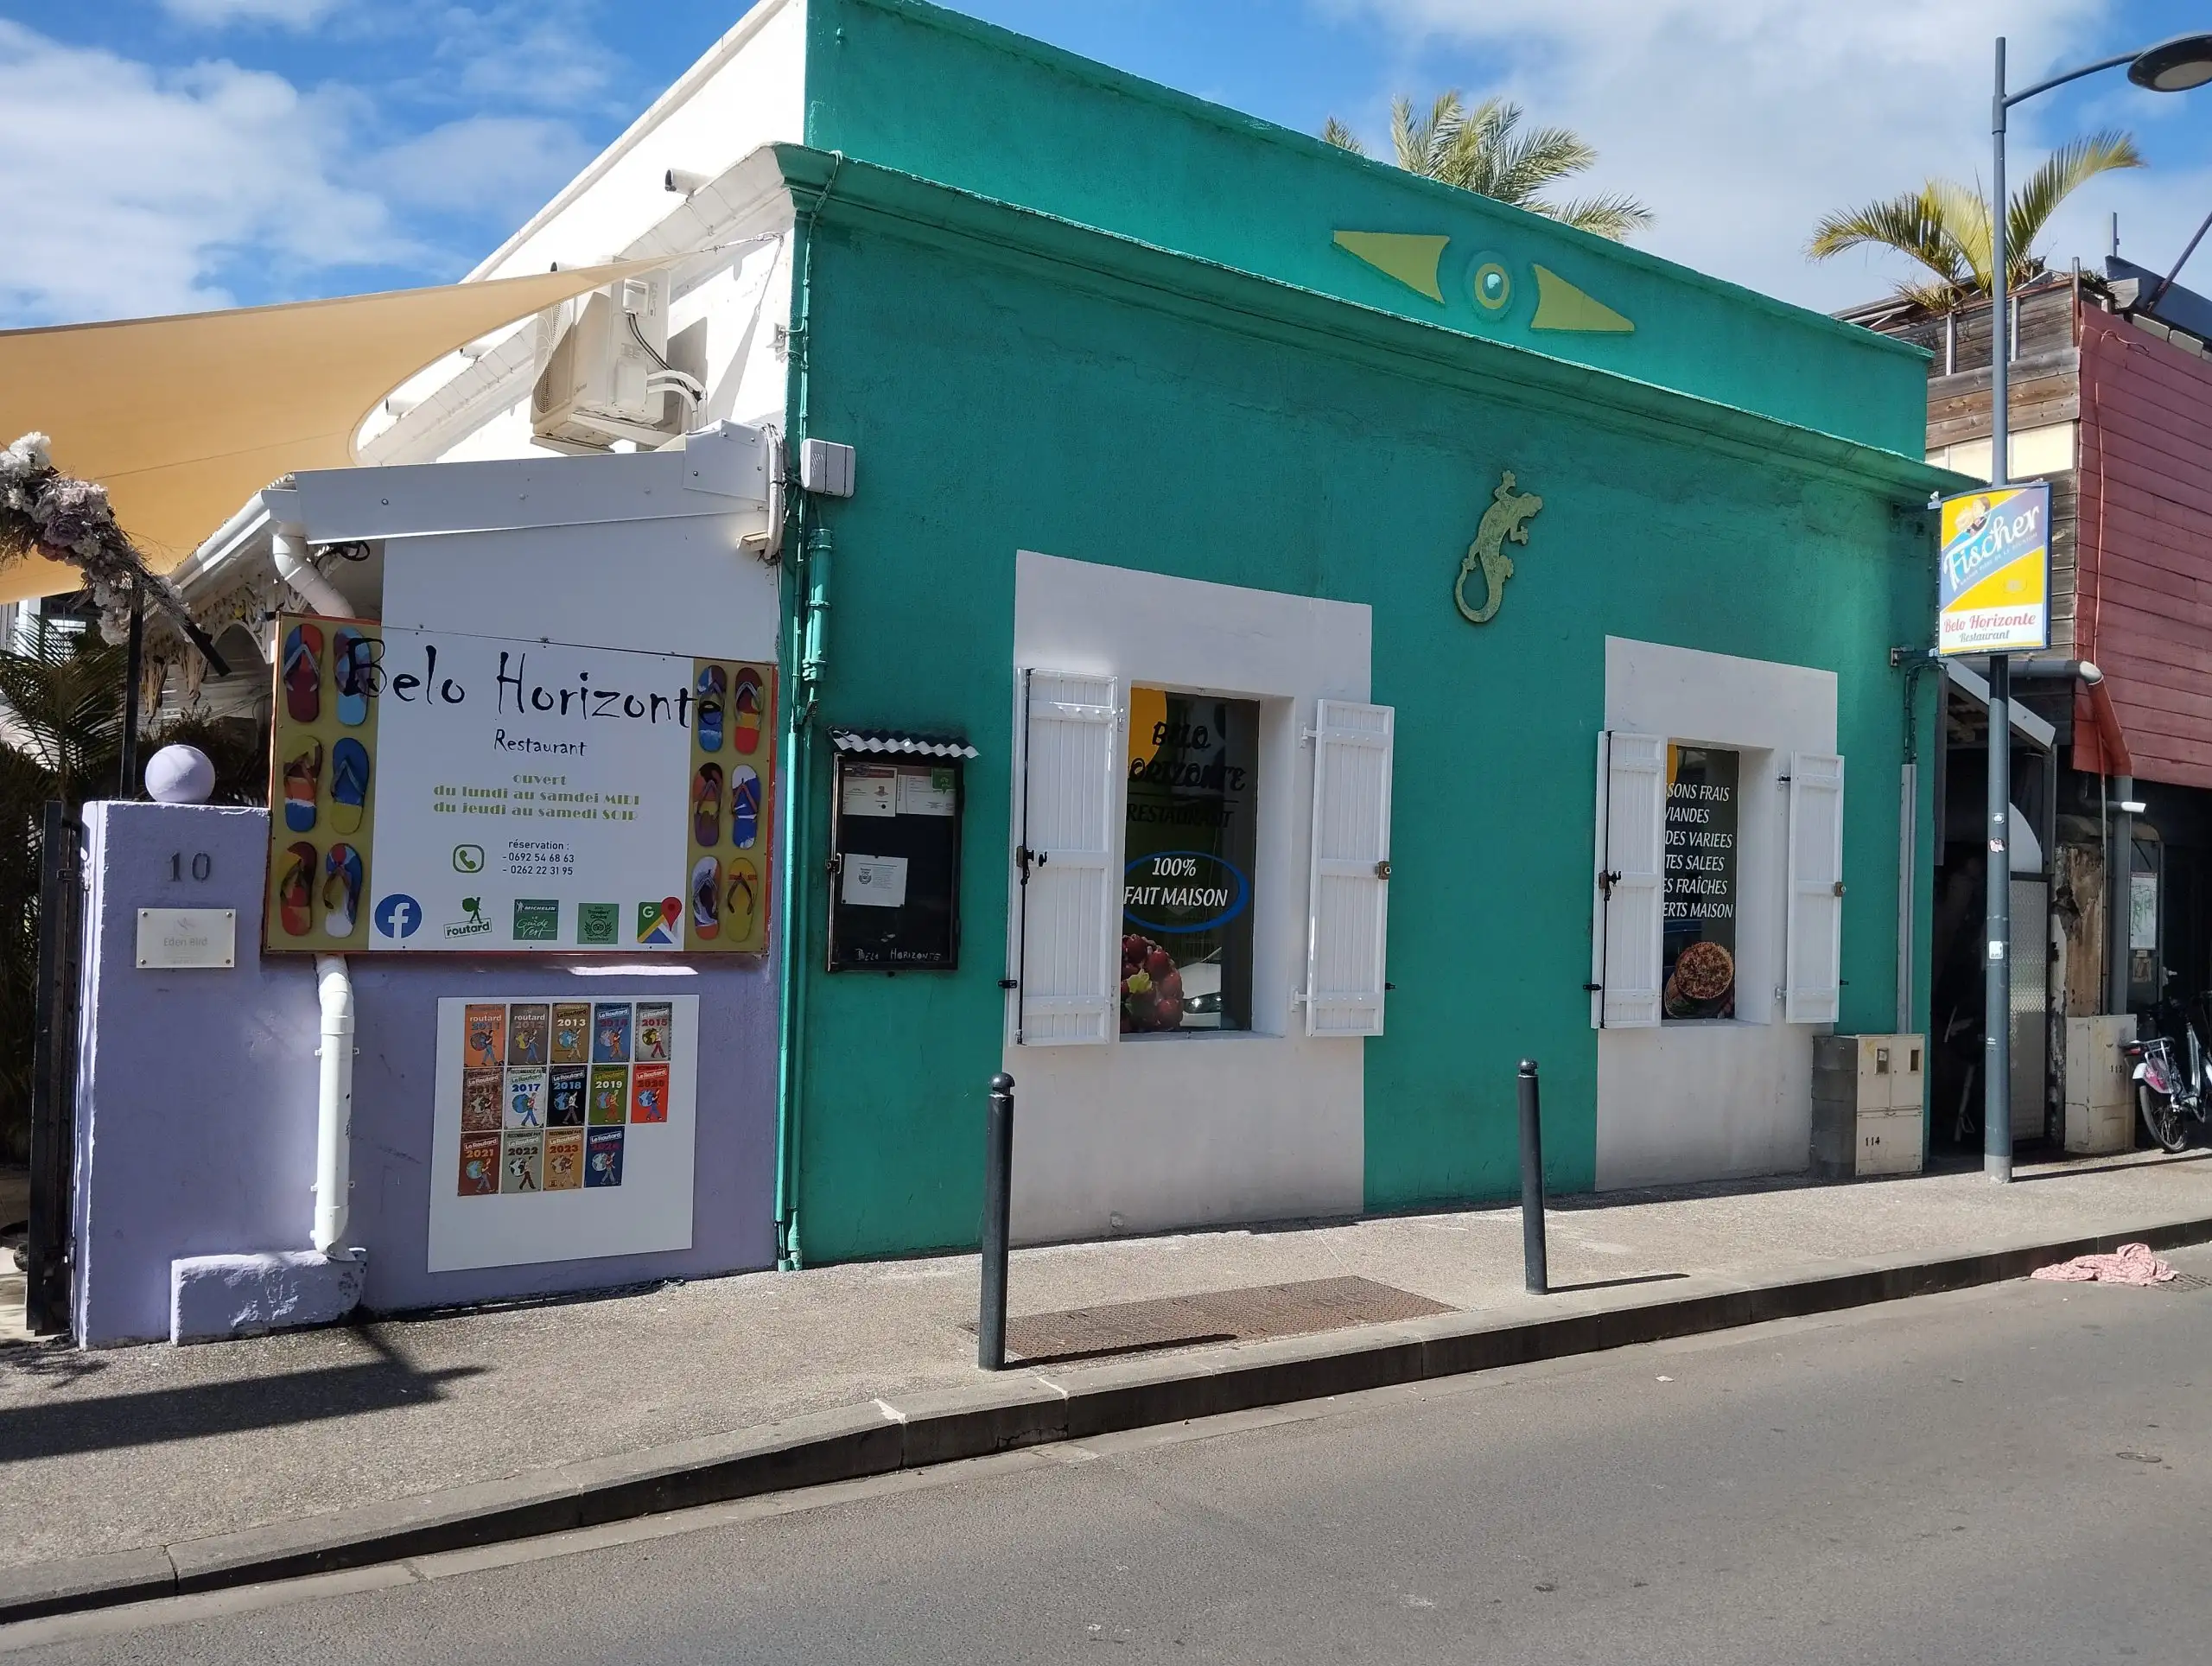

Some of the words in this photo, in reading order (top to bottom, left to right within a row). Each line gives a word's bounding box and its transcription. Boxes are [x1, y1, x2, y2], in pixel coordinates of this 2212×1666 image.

[1944, 506, 2039, 593] Fischer
[1944, 618, 1966, 633] Belo
[1969, 613, 2036, 630] Horizonte
[1960, 630, 2010, 643] Restaurant
[346, 637, 466, 705] Belo
[495, 652, 724, 728] Horizonte
[493, 729, 588, 757] Restaurant
[513, 774, 567, 785] ouvert
[433, 785, 456, 796] du
[462, 786, 508, 798] lundi
[513, 790, 534, 800] au
[539, 792, 599, 804] samdei
[603, 794, 639, 805] MIDI
[1700, 785, 1730, 802] FRAIS
[433, 802, 456, 812] du
[461, 802, 506, 815] jeudi
[512, 806, 533, 816] au
[537, 809, 597, 819] samedi
[508, 839, 564, 850] réservation
[1688, 832, 1733, 849] VARIEES
[534, 853, 546, 862] 54
[549, 854, 561, 862] 68
[563, 854, 575, 863] 63
[1686, 855, 1725, 871] SALEES
[168, 851, 211, 882] 10
[536, 866, 547, 874] 22
[562, 867, 573, 875] 95
[1152, 857, 1197, 876] 100%
[1676, 875, 1728, 895] FRAÎCHES
[1123, 886, 1160, 906] FAIT
[1161, 887, 1228, 907] MAISON
[1689, 903, 1733, 919] MAISON
[447, 921, 490, 936] routard
[516, 919, 549, 929] Guide
[522, 926, 556, 938] Vert
[163, 938, 187, 946] Eden
[561, 1071, 583, 1080] Routard
[512, 1084, 541, 1092] 2017
[473, 1138, 498, 1148] Routard
[515, 1137, 540, 1146] Routard
[556, 1135, 582, 1144] Routard
[599, 1133, 621, 1141] Routard
[1865, 1136, 1880, 1147] 114
[465, 1148, 494, 1159] 2021
[507, 1147, 538, 1156] 2022
[550, 1145, 579, 1154] 2023
